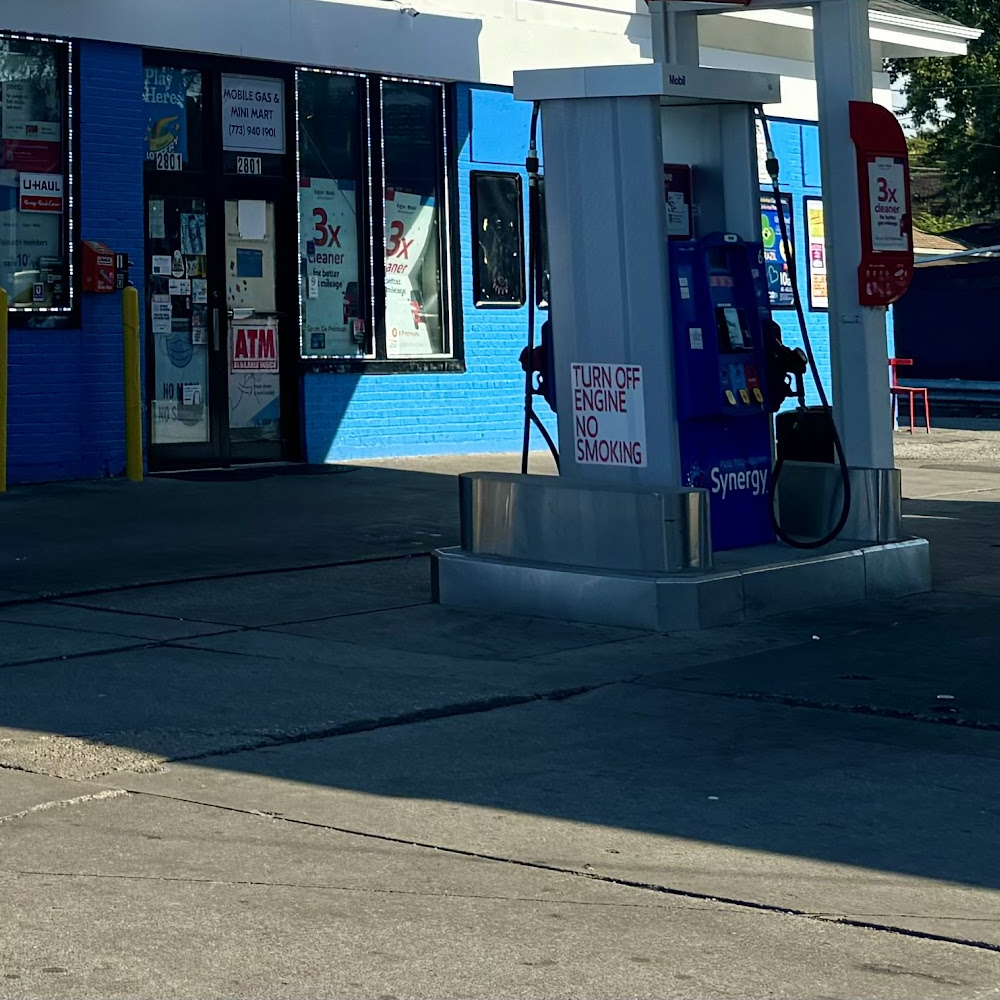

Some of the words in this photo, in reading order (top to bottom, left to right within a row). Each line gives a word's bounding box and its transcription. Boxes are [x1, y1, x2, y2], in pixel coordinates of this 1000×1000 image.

[144, 68, 178, 91] Play
[669, 74, 686, 86] Mobil
[146, 87, 179, 104] Here
[223, 89, 254, 101] MOBILE
[255, 91, 271, 103] GAS
[273, 93, 280, 104] &
[231, 106, 249, 118] MINI
[250, 108, 274, 120] MART
[228, 124, 245, 137] (773)
[247, 126, 261, 136] 940
[262, 127, 276, 138] 1901
[157, 153, 183, 171] 2801
[237, 157, 262, 175] 2801
[877, 177, 898, 203] 3x
[874, 203, 901, 214] cleaner
[312, 207, 342, 248] 3x
[386, 220, 415, 260] 3x
[308, 252, 345, 265] cleaner
[235, 329, 276, 359] ATM
[572, 365, 612, 388] TURN
[615, 366, 641, 390] OFF
[163, 382, 174, 400] NO
[575, 389, 628, 413] ENGINE
[576, 415, 598, 438] NO
[577, 438, 642, 465] SMOKING
[710, 466, 769, 500] Synergy
